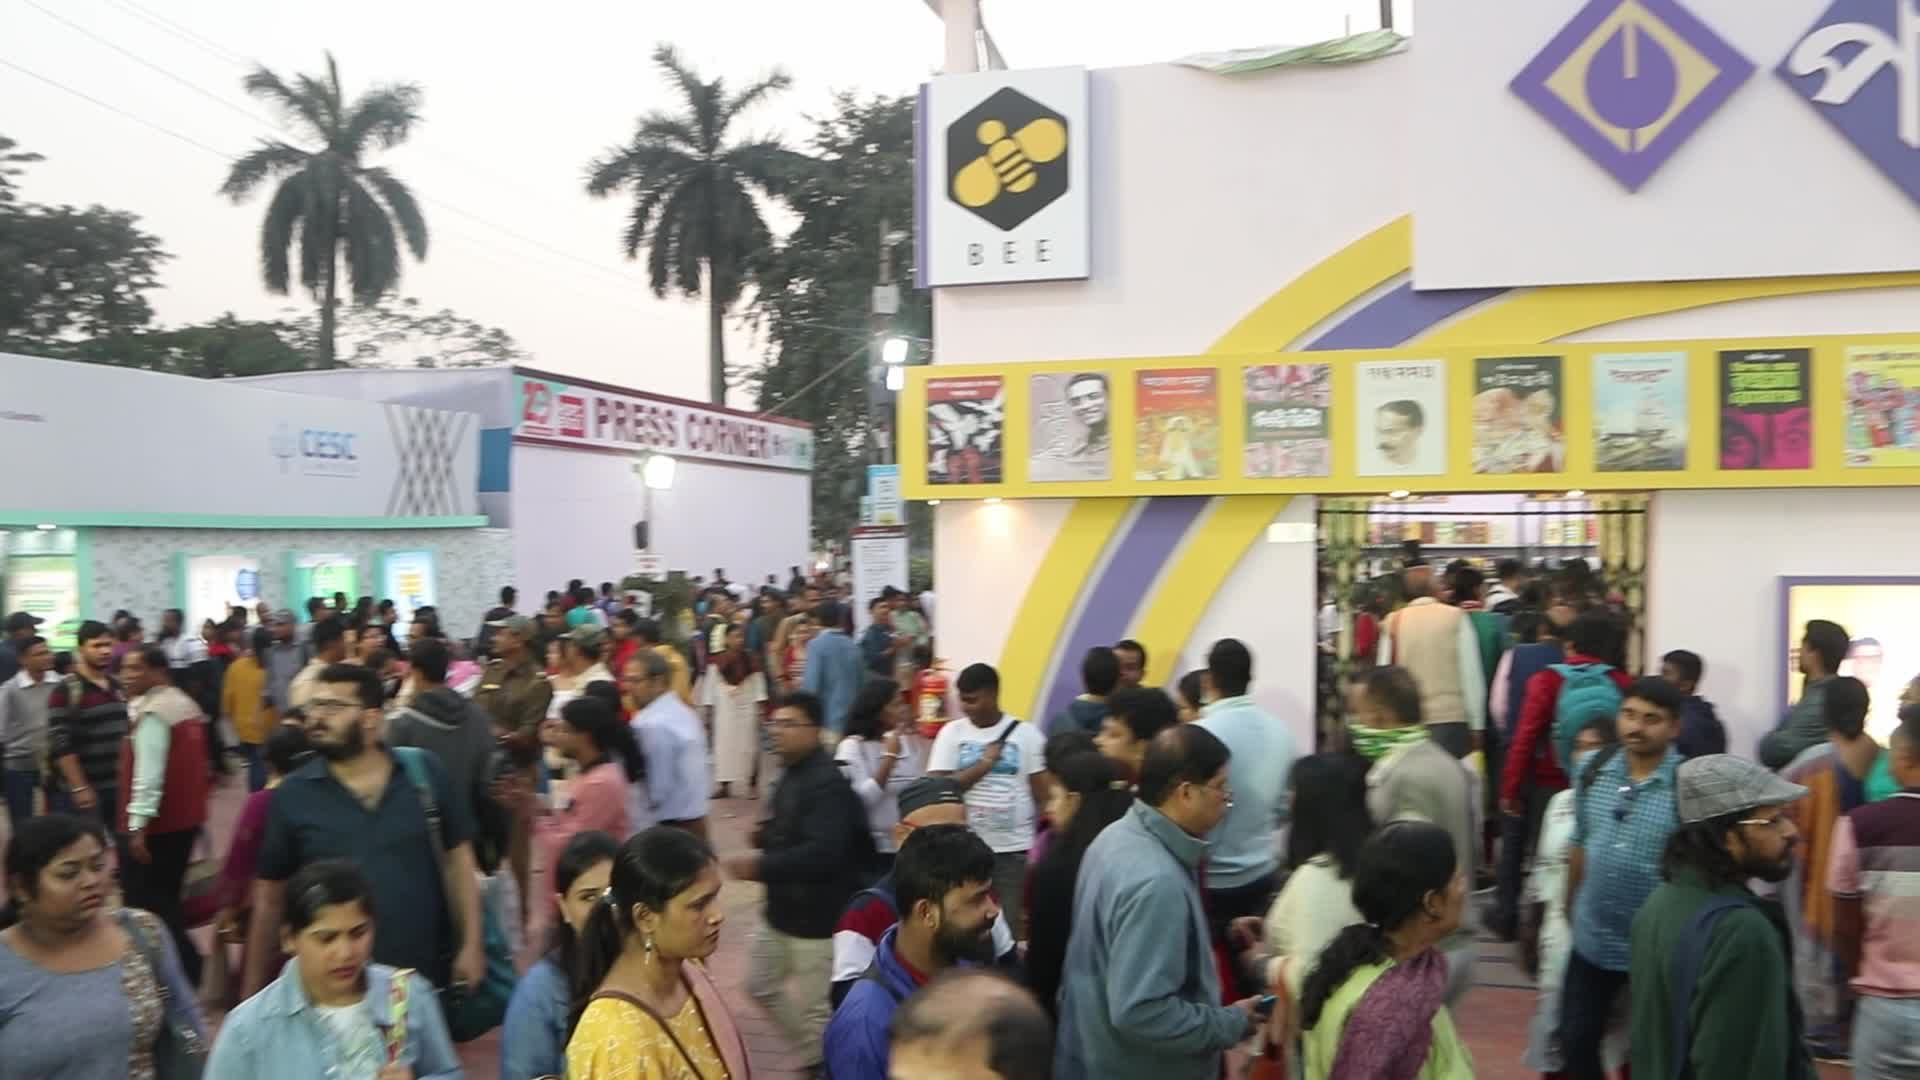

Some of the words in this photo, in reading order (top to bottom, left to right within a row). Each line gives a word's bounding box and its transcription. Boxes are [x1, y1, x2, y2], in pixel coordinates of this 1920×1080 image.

[967, 239, 1052, 266] BEE
[595, 396, 679, 447] PRESS
[686, 412, 769, 459] CORNER
[300, 428, 359, 461] CESC
